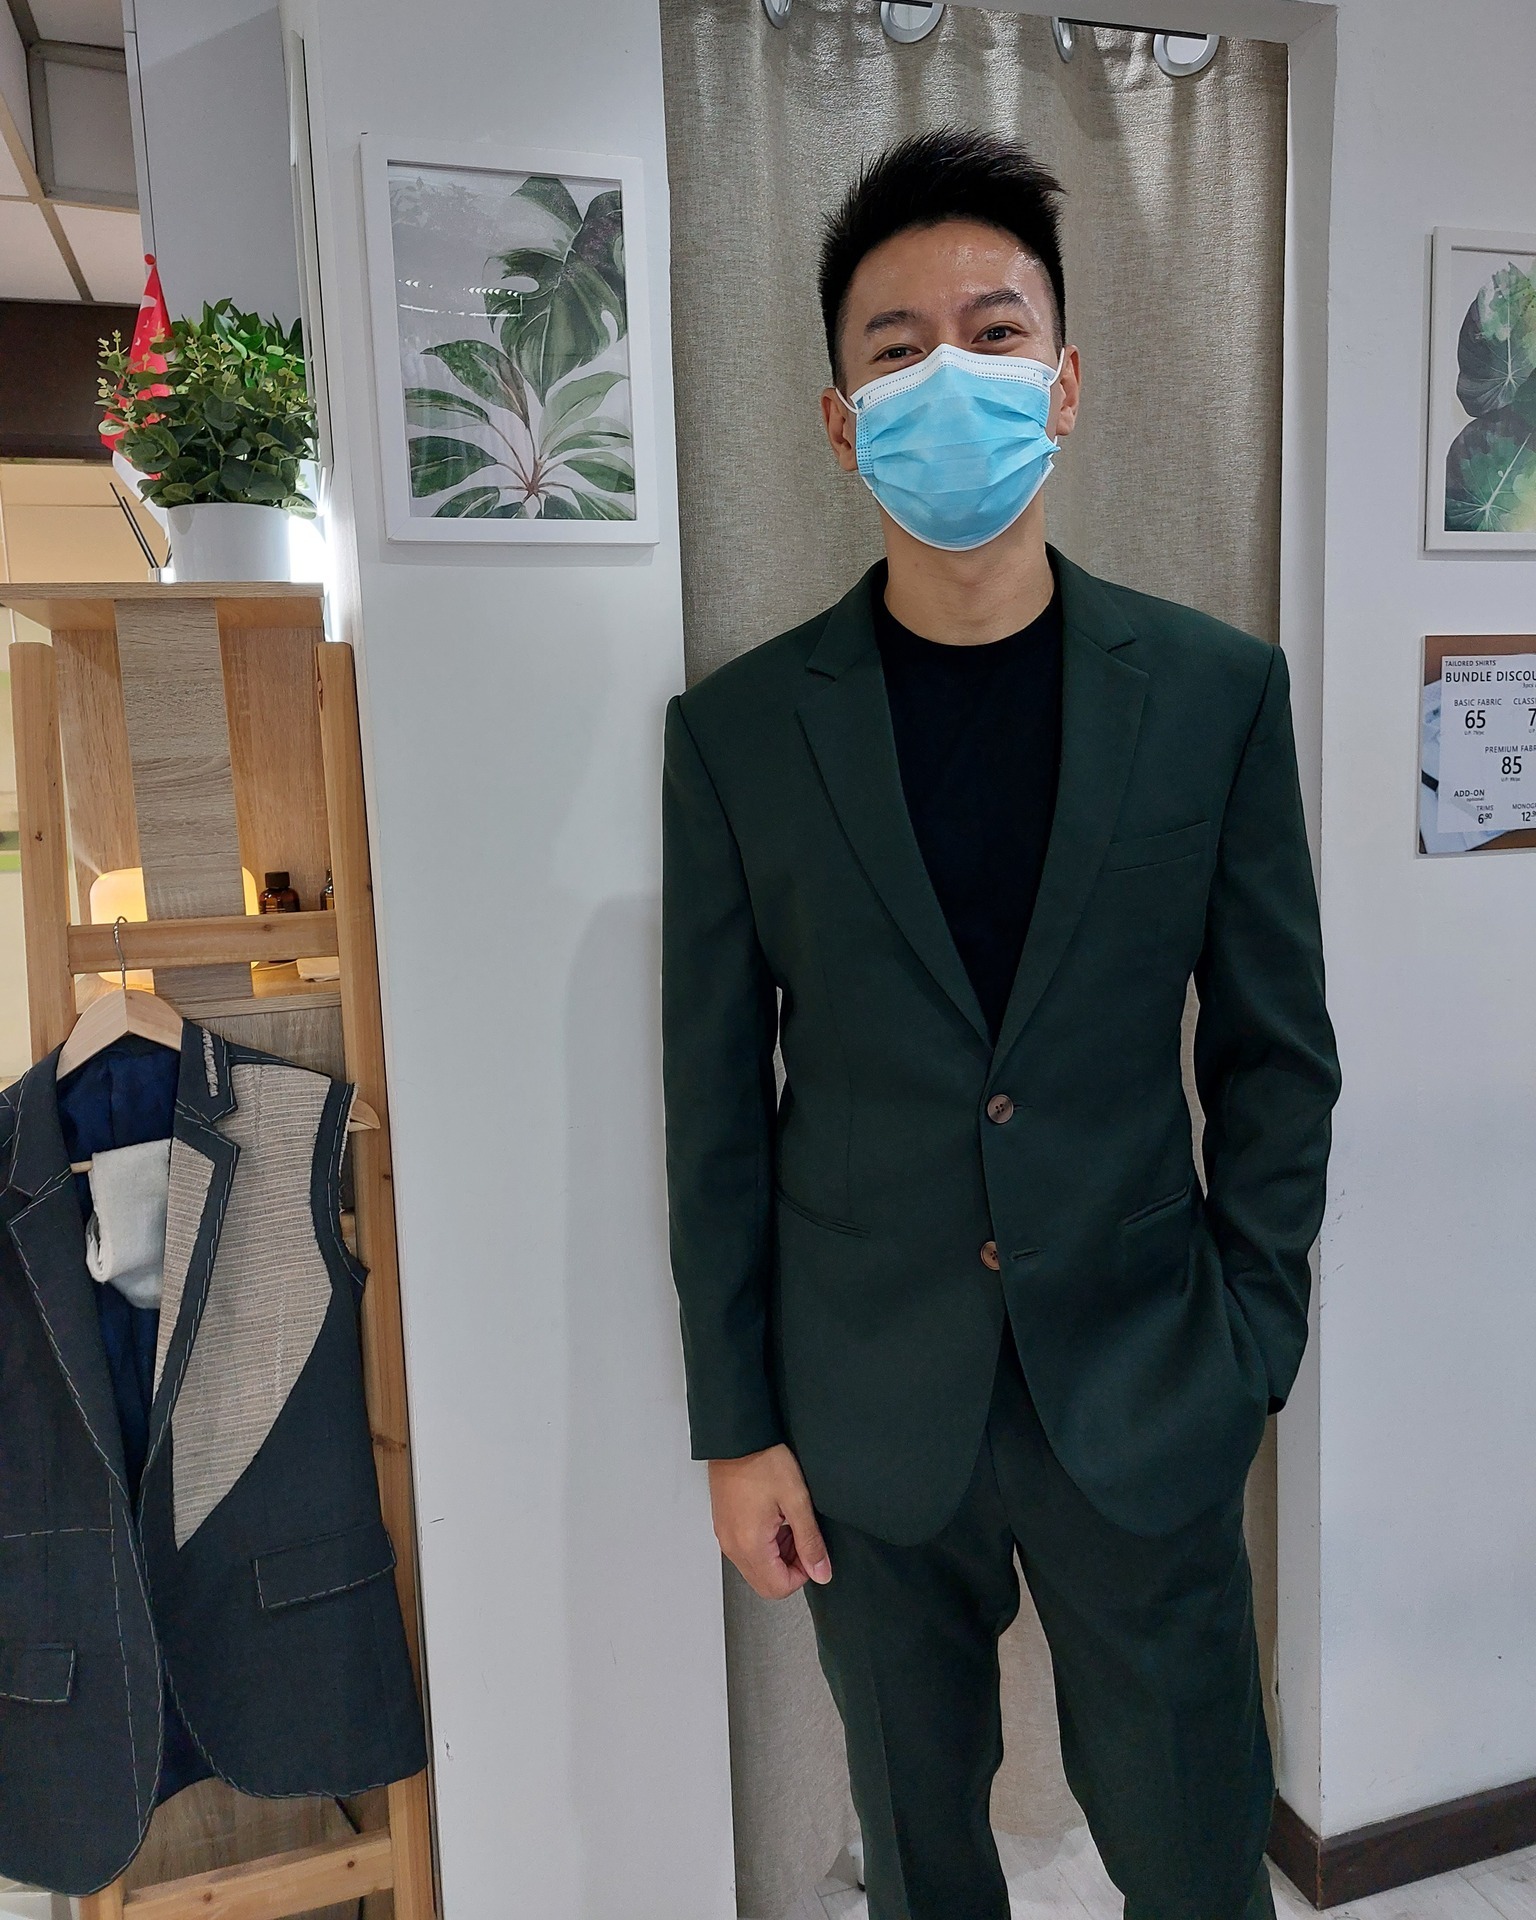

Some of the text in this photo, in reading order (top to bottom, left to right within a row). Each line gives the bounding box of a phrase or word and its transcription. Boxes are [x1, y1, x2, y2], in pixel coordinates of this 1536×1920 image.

[1445, 672, 1492, 682] BUNDLE
[1465, 710, 1486, 728] 65
[1502, 756, 1522, 774] 85
